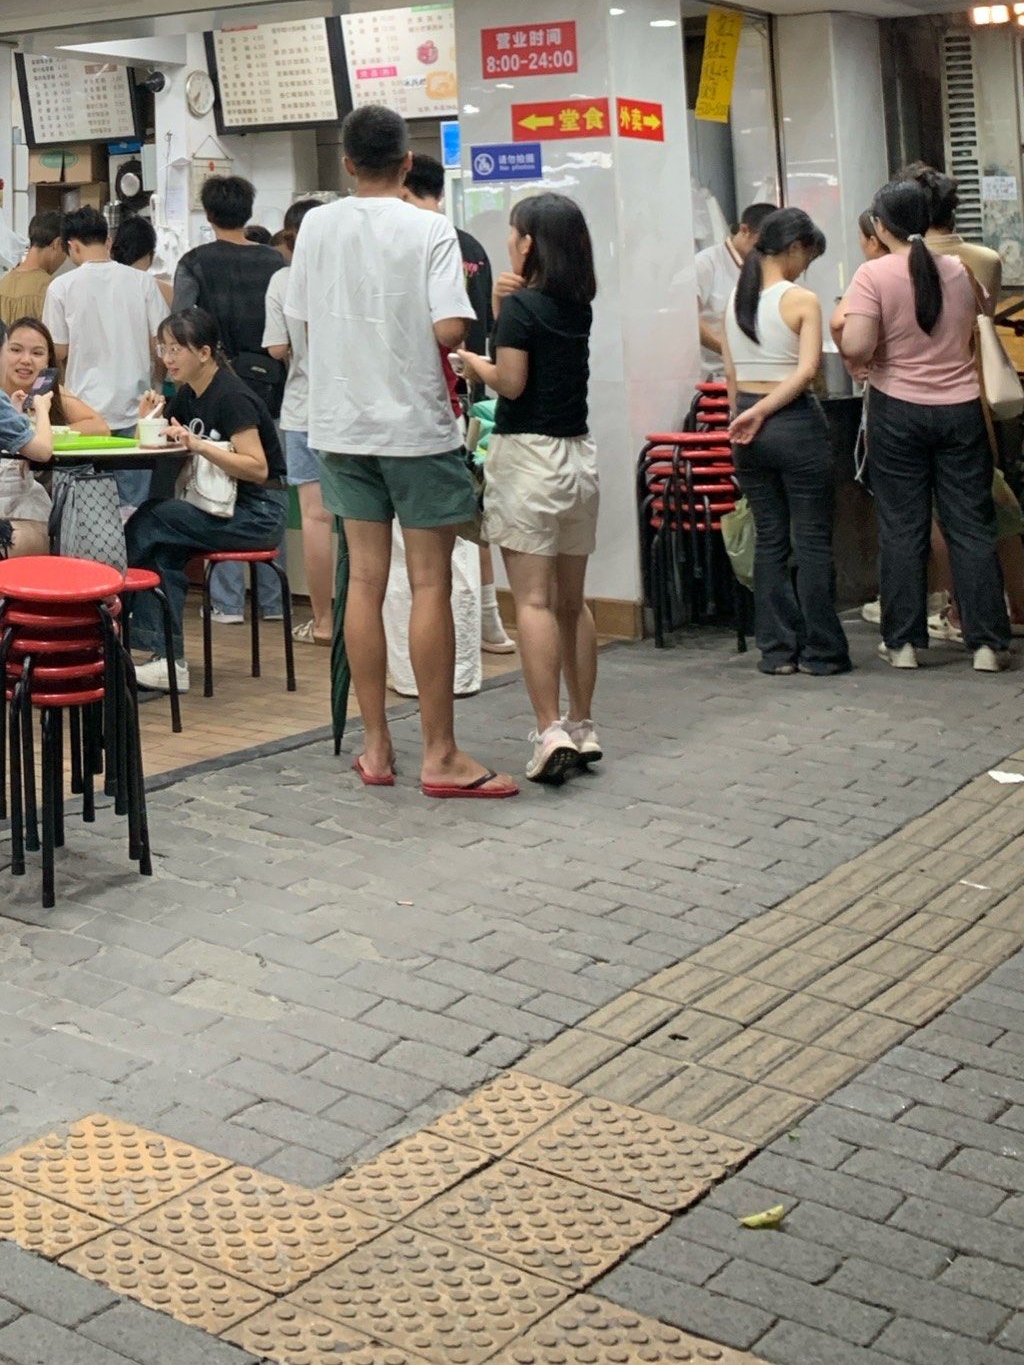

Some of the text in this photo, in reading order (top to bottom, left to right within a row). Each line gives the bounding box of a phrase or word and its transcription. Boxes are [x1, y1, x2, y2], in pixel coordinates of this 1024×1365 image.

[496, 28, 562, 49] 营业时间
[487, 50, 573, 73] 8:00-24:00
[558, 107, 604, 131] 堂食
[620, 106, 642, 131] 外卖
